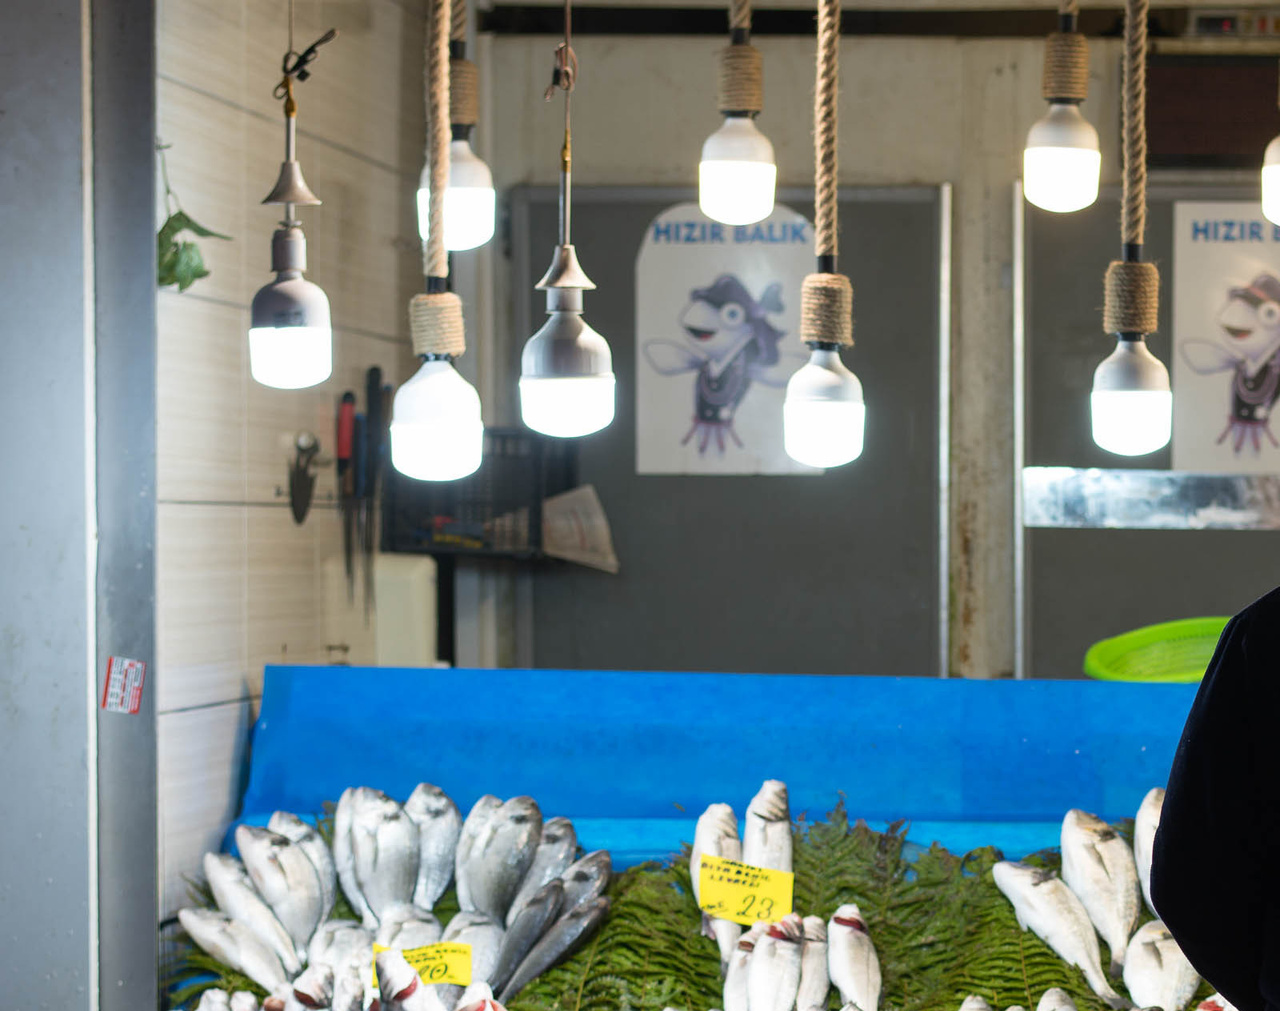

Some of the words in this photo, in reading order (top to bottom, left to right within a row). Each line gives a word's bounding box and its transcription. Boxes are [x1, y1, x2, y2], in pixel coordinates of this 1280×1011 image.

[654, 221, 724, 244] HIZIR
[734, 222, 807, 244] BALIK
[1192, 220, 1264, 242] HIZIR
[735, 894, 774, 919] 23
